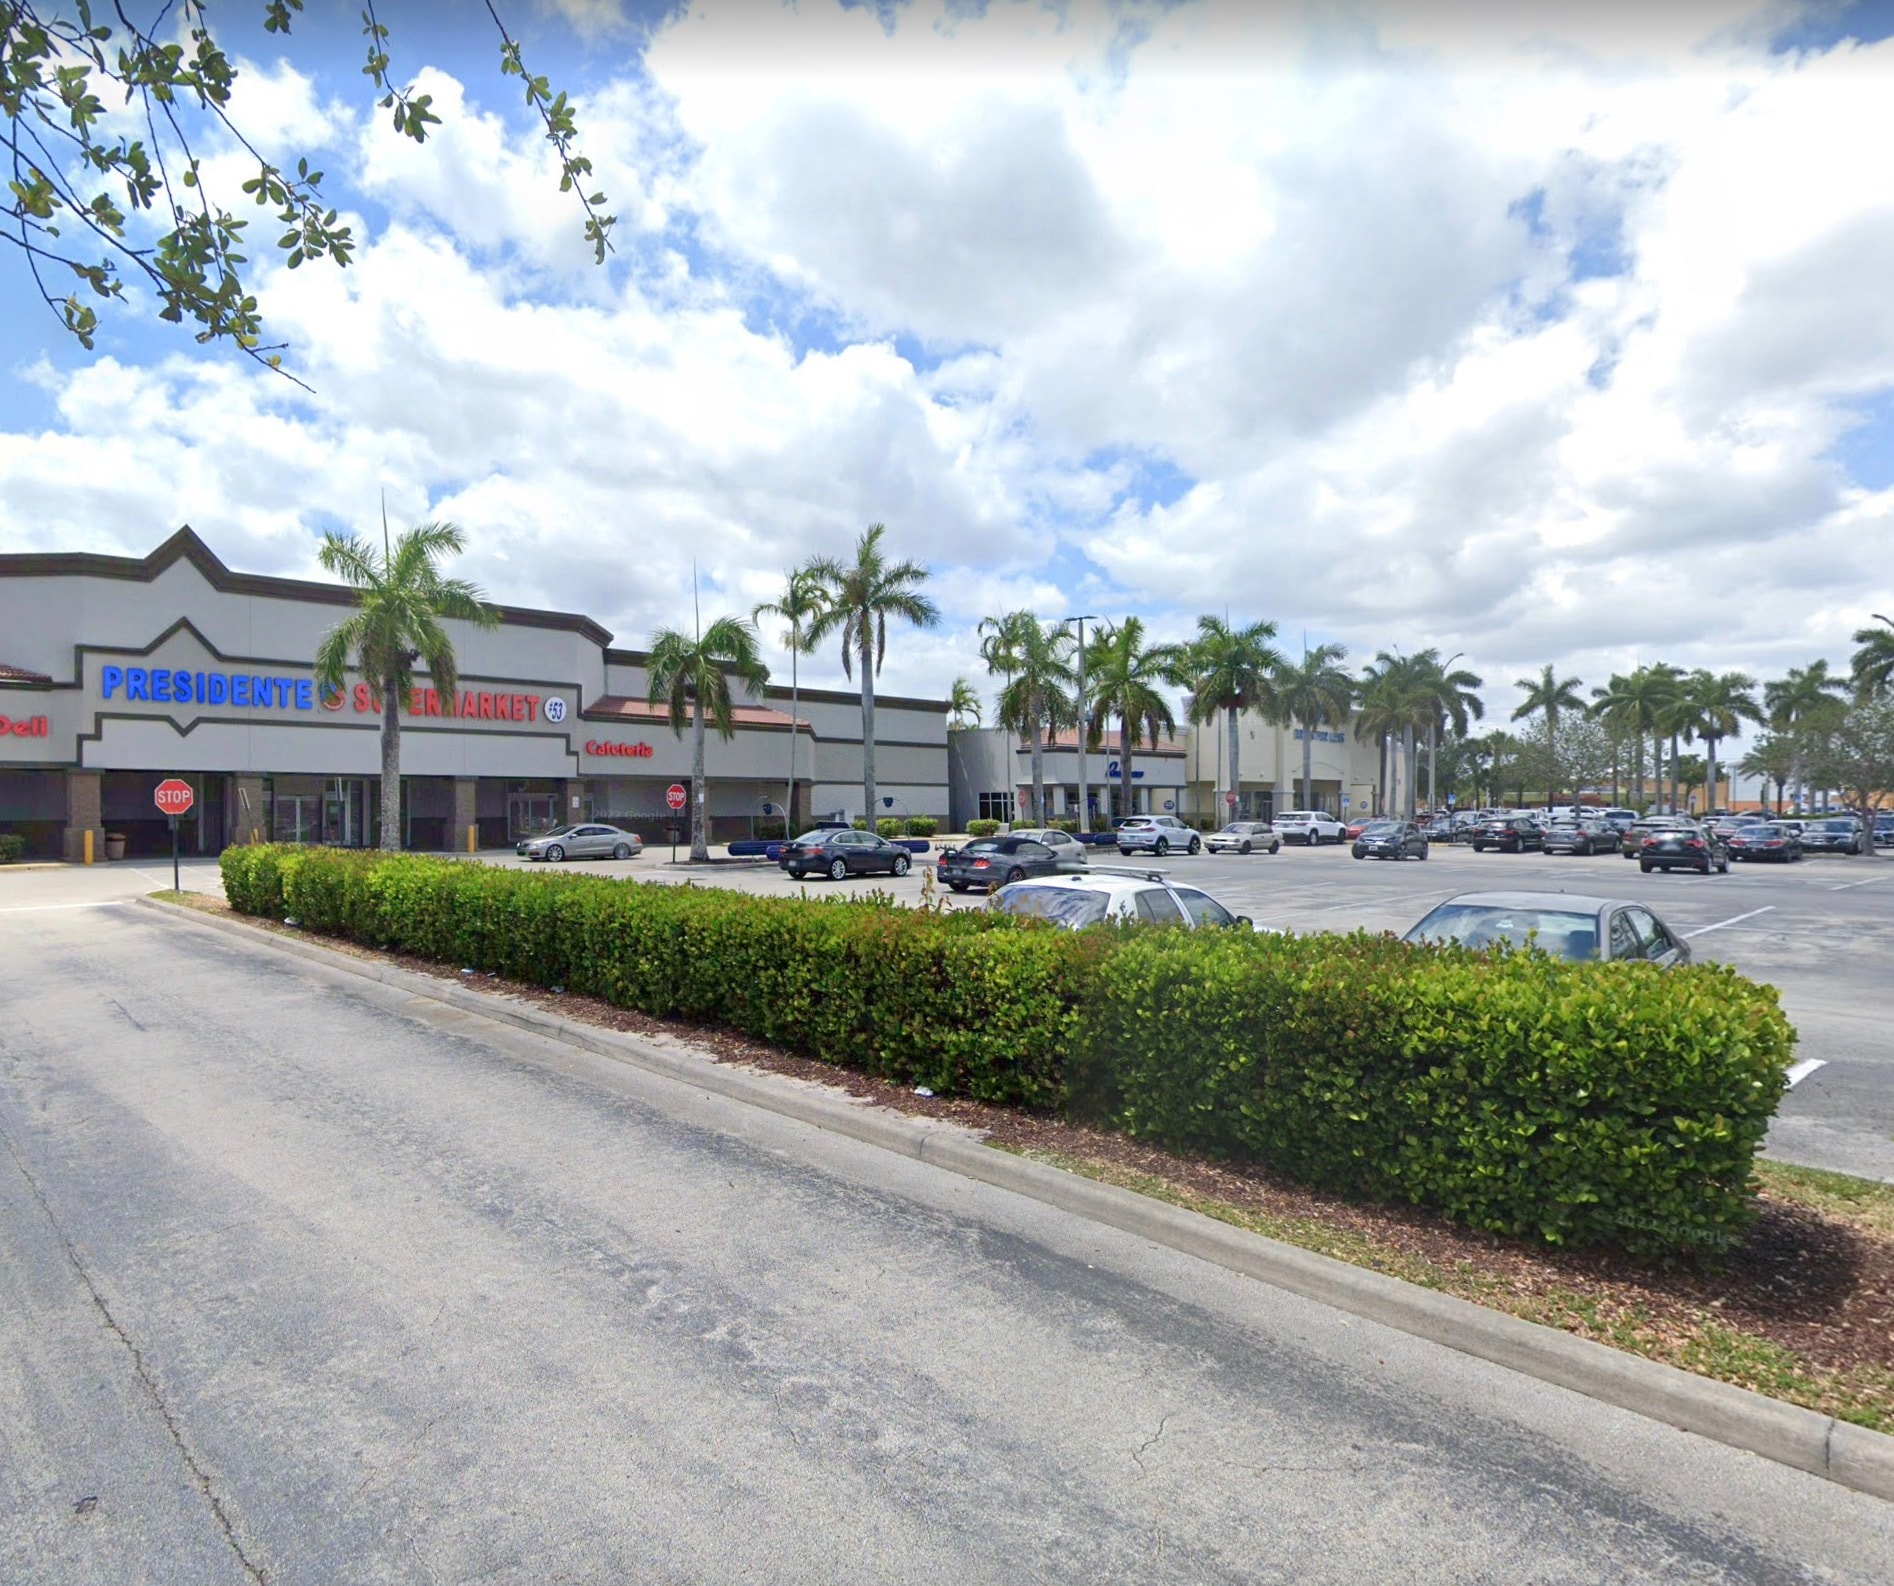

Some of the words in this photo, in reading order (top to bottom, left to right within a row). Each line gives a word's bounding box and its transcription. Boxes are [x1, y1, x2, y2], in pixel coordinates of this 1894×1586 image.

[102, 666, 313, 709] PRESIDENTE
[353, 684, 540, 721] SERARKET
[586, 740, 653, 757] Cafeteria
[158, 790, 190, 803] STOP
[668, 791, 685, 801] STOP
